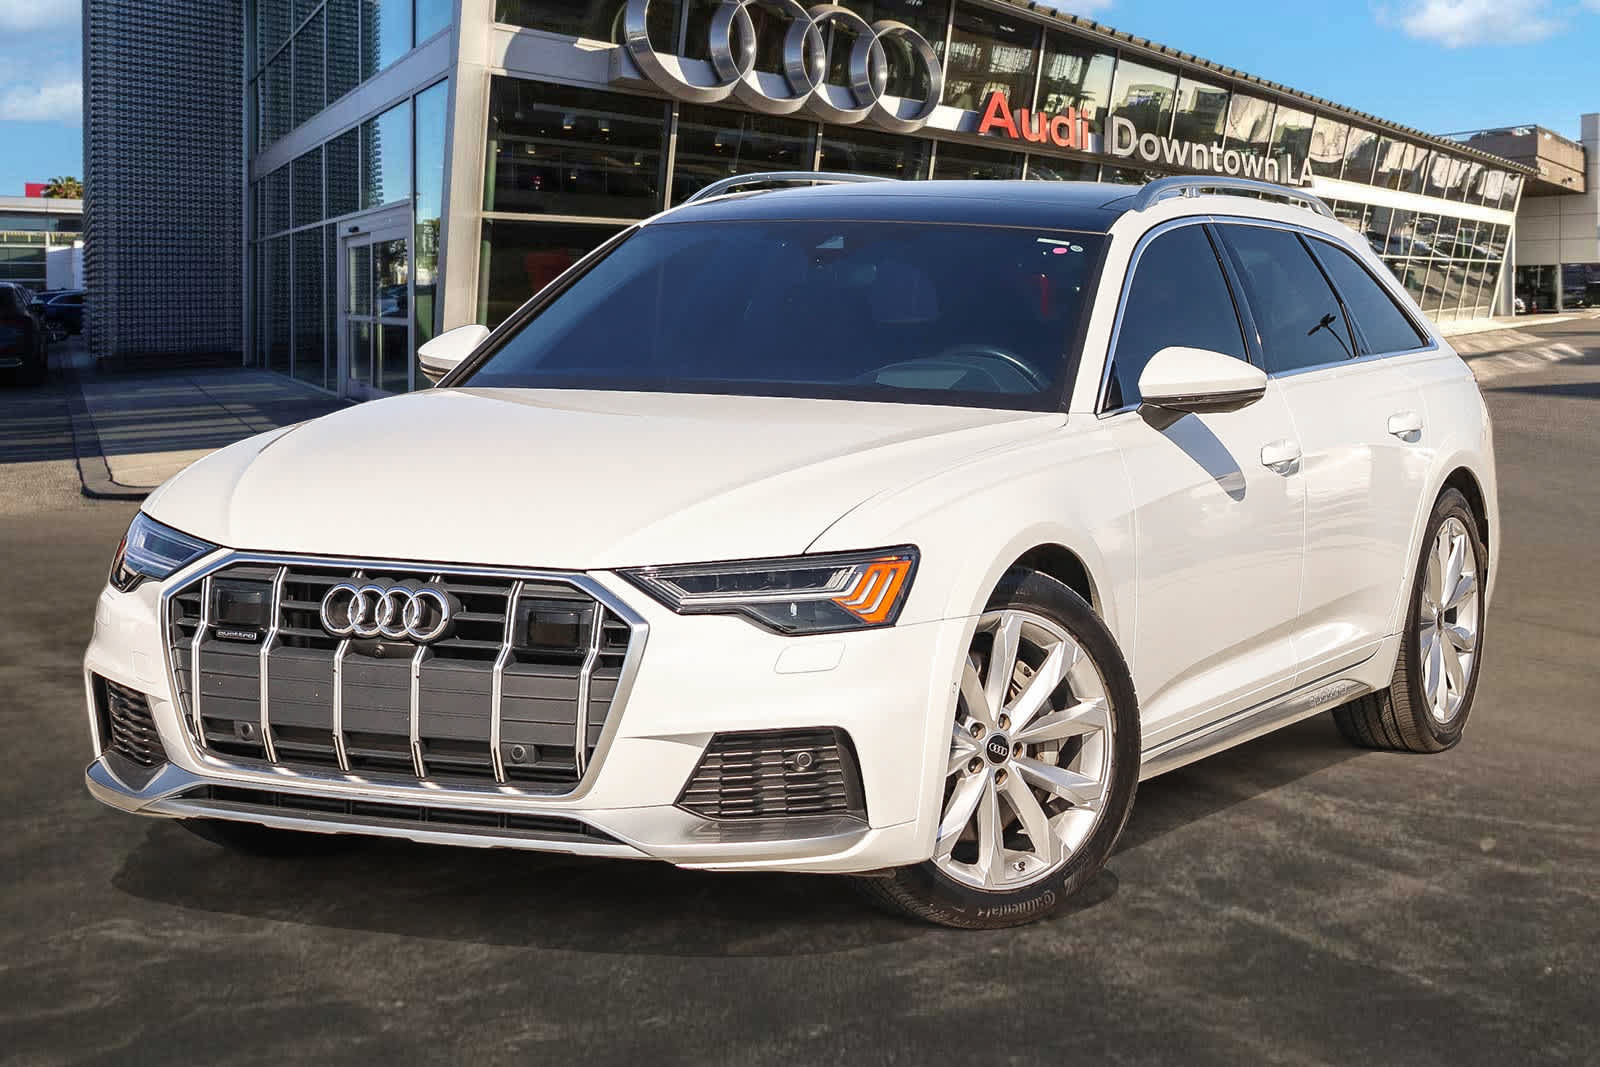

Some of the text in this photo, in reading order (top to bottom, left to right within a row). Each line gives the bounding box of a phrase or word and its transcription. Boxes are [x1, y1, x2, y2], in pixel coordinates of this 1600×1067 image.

[978, 90, 1314, 187] Audi Downtown LA
